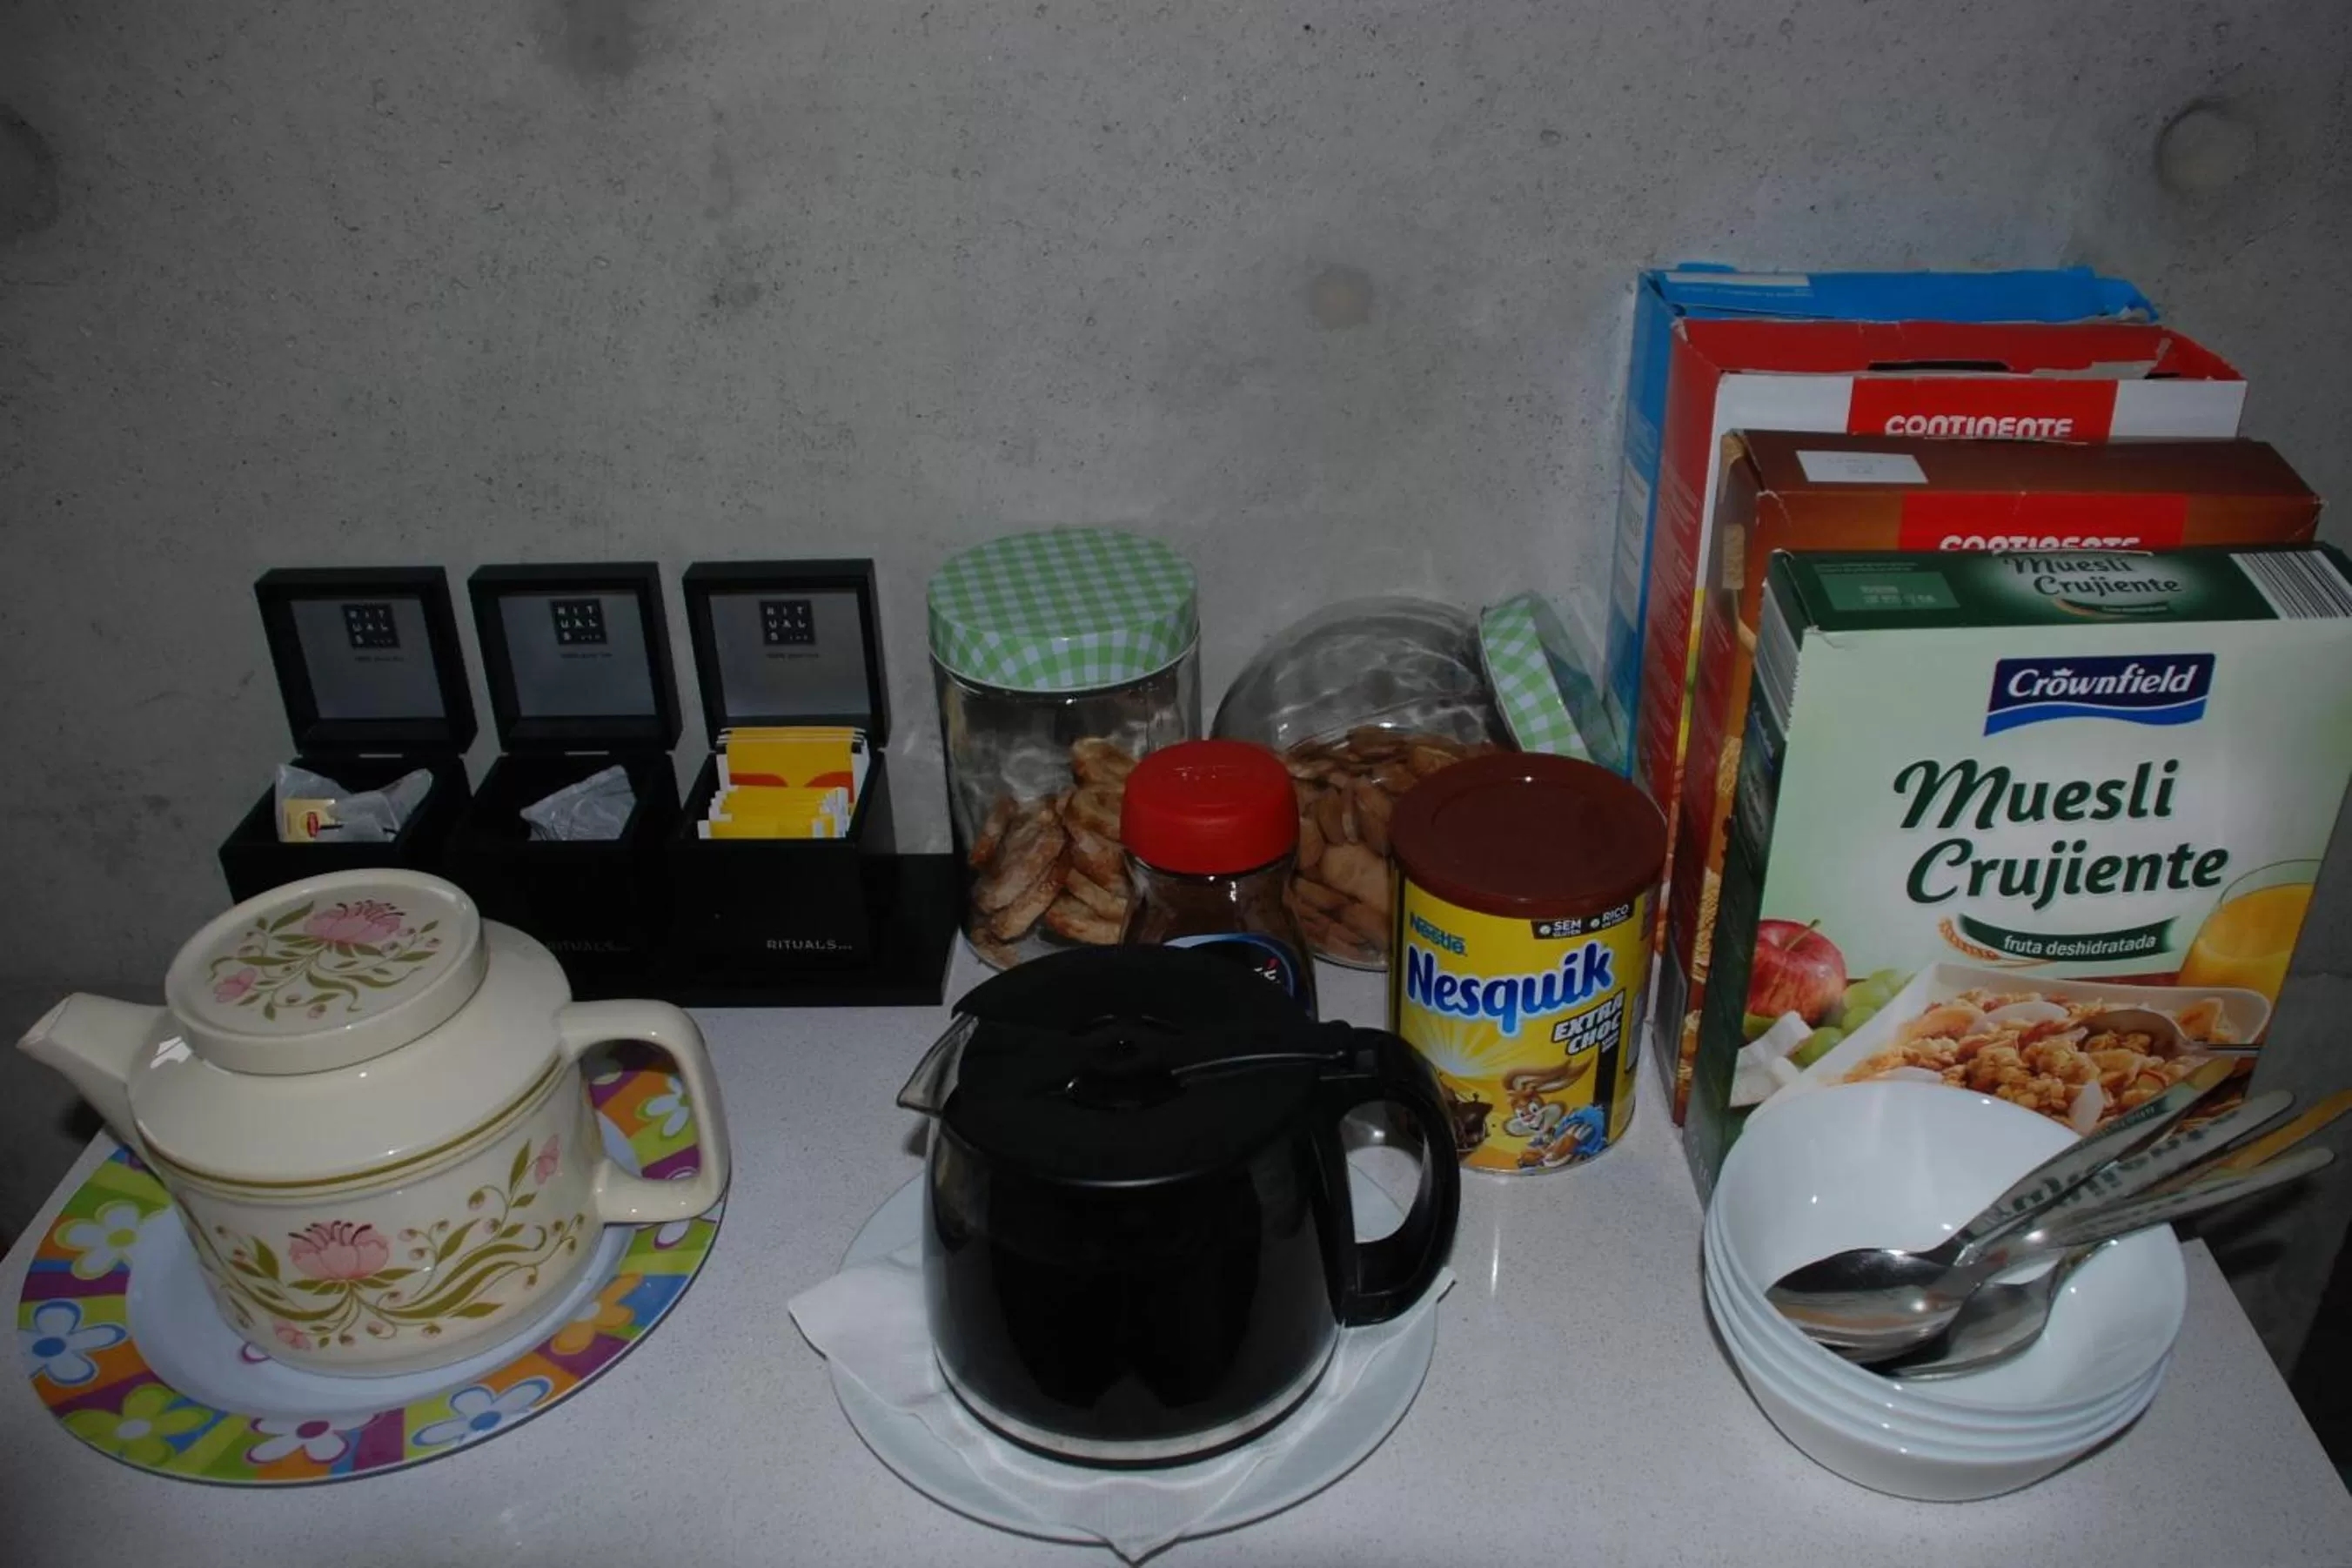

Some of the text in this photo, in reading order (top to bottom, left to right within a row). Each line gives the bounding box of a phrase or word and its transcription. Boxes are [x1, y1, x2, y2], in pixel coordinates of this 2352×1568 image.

[1884, 414, 2074, 439] CONTINENTE
[2003, 555, 2134, 574] Muesli
[2033, 573, 2183, 598] Crujiente
[2007, 663, 2199, 700] Crownfield
[1893, 759, 2180, 830] Muesli
[1906, 838, 2229, 911] Crujiente
[1552, 919, 1582, 931] SEM
[1601, 903, 1630, 922] RICO
[2003, 934, 2157, 955] fruta deshidratada
[1407, 942, 1612, 1034] Nesquik
[1552, 990, 1625, 1042] EXTRA
[1567, 1009, 1623, 1055] CHOC
